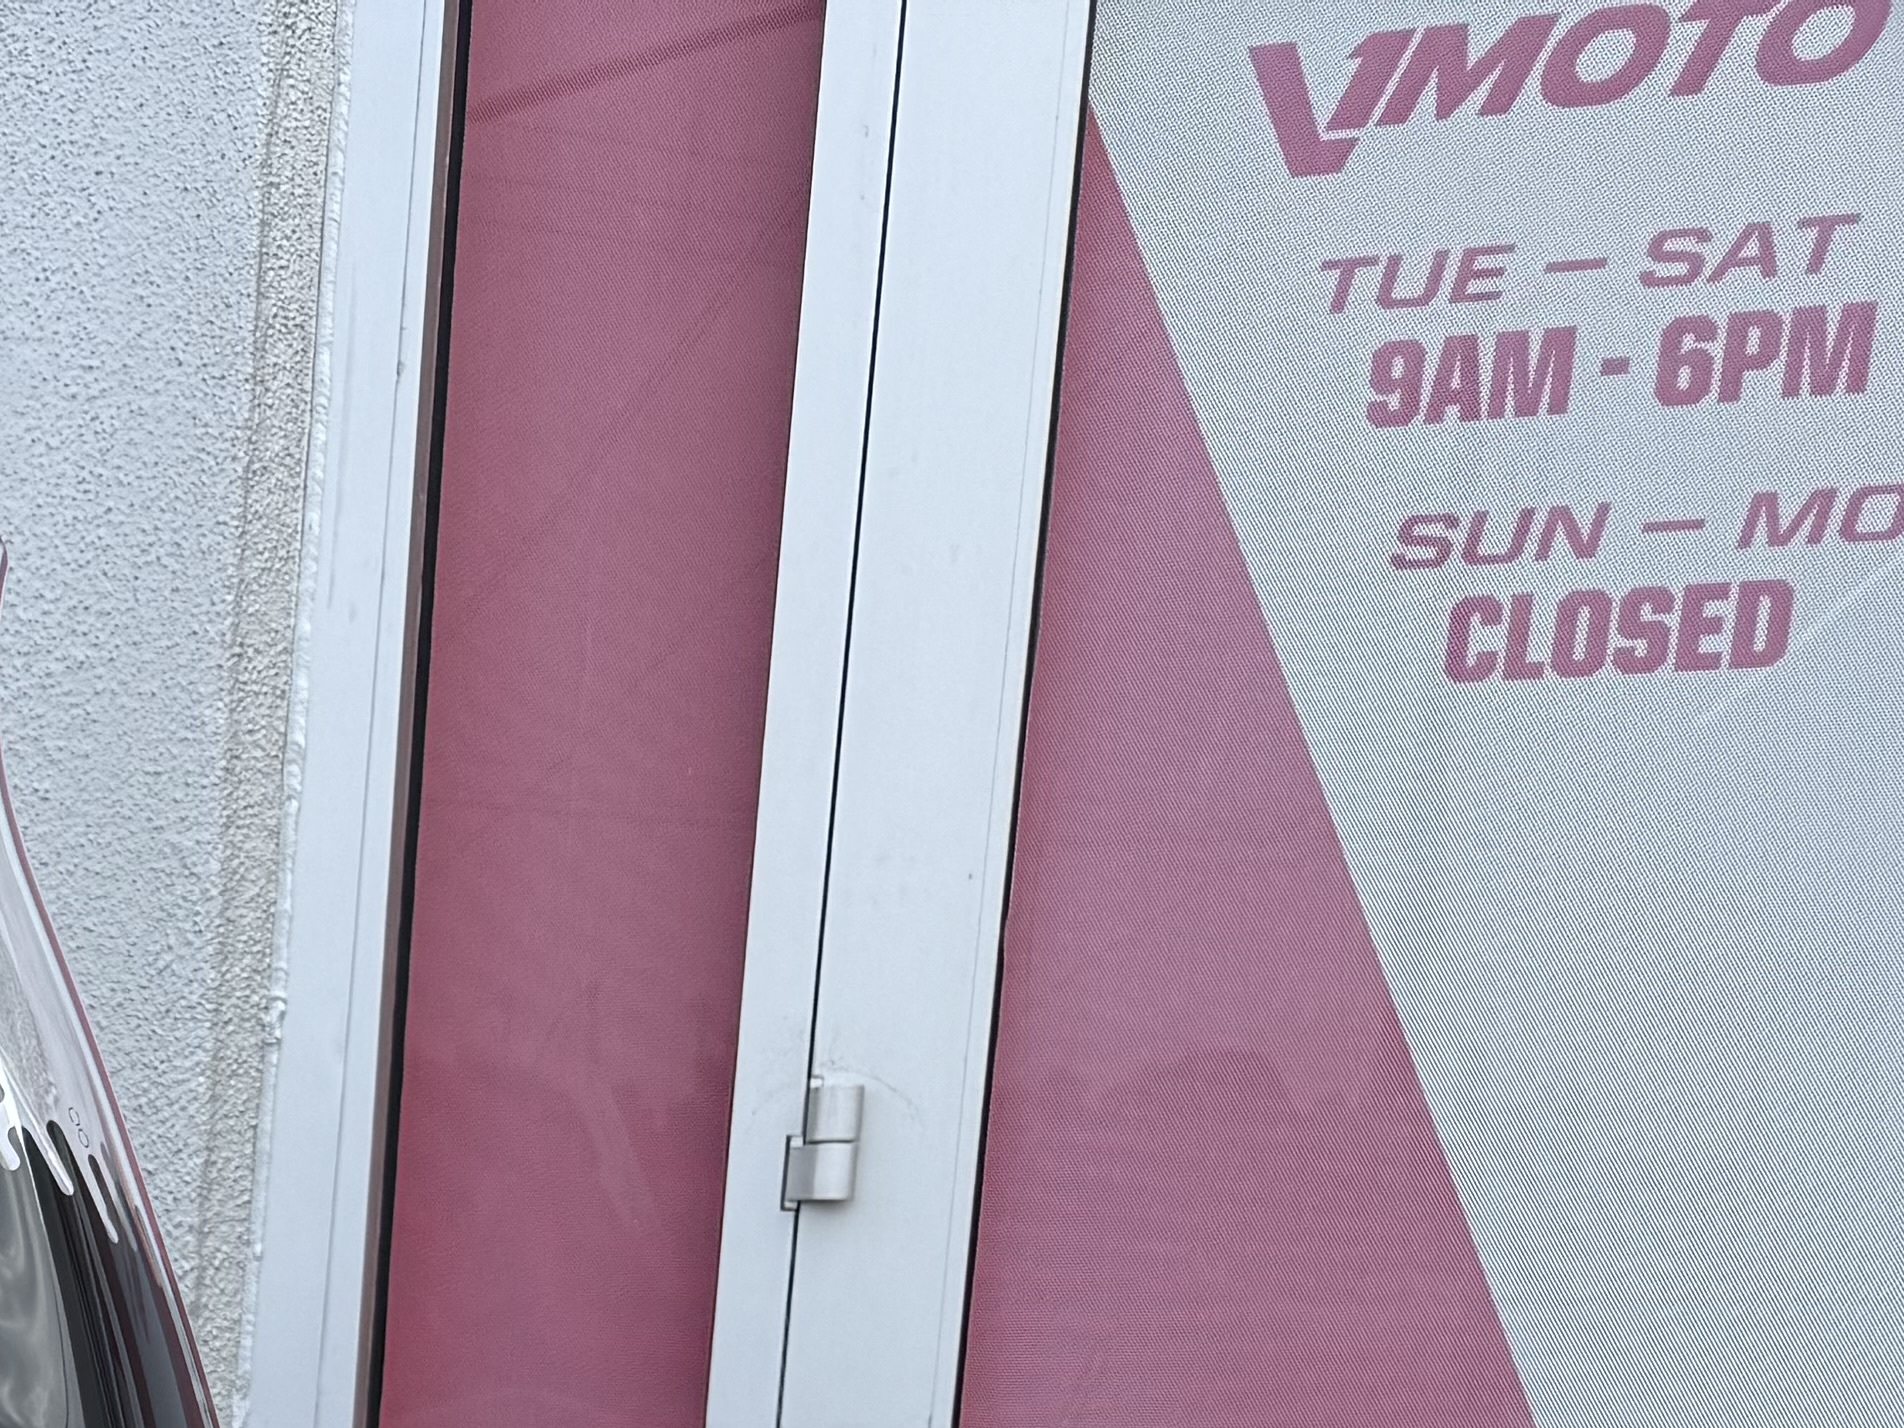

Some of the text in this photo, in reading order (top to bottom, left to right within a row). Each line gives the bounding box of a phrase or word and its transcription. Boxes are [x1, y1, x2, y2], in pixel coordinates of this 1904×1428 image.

[1319, 243, 1517, 315] TUE
[1639, 212, 1862, 289] SAT
[1365, 324, 1578, 429] 9AM
[1652, 299, 1880, 409] 6PM
[1392, 501, 1611, 571] SUN
[1443, 579, 1793, 684] CLOSED
